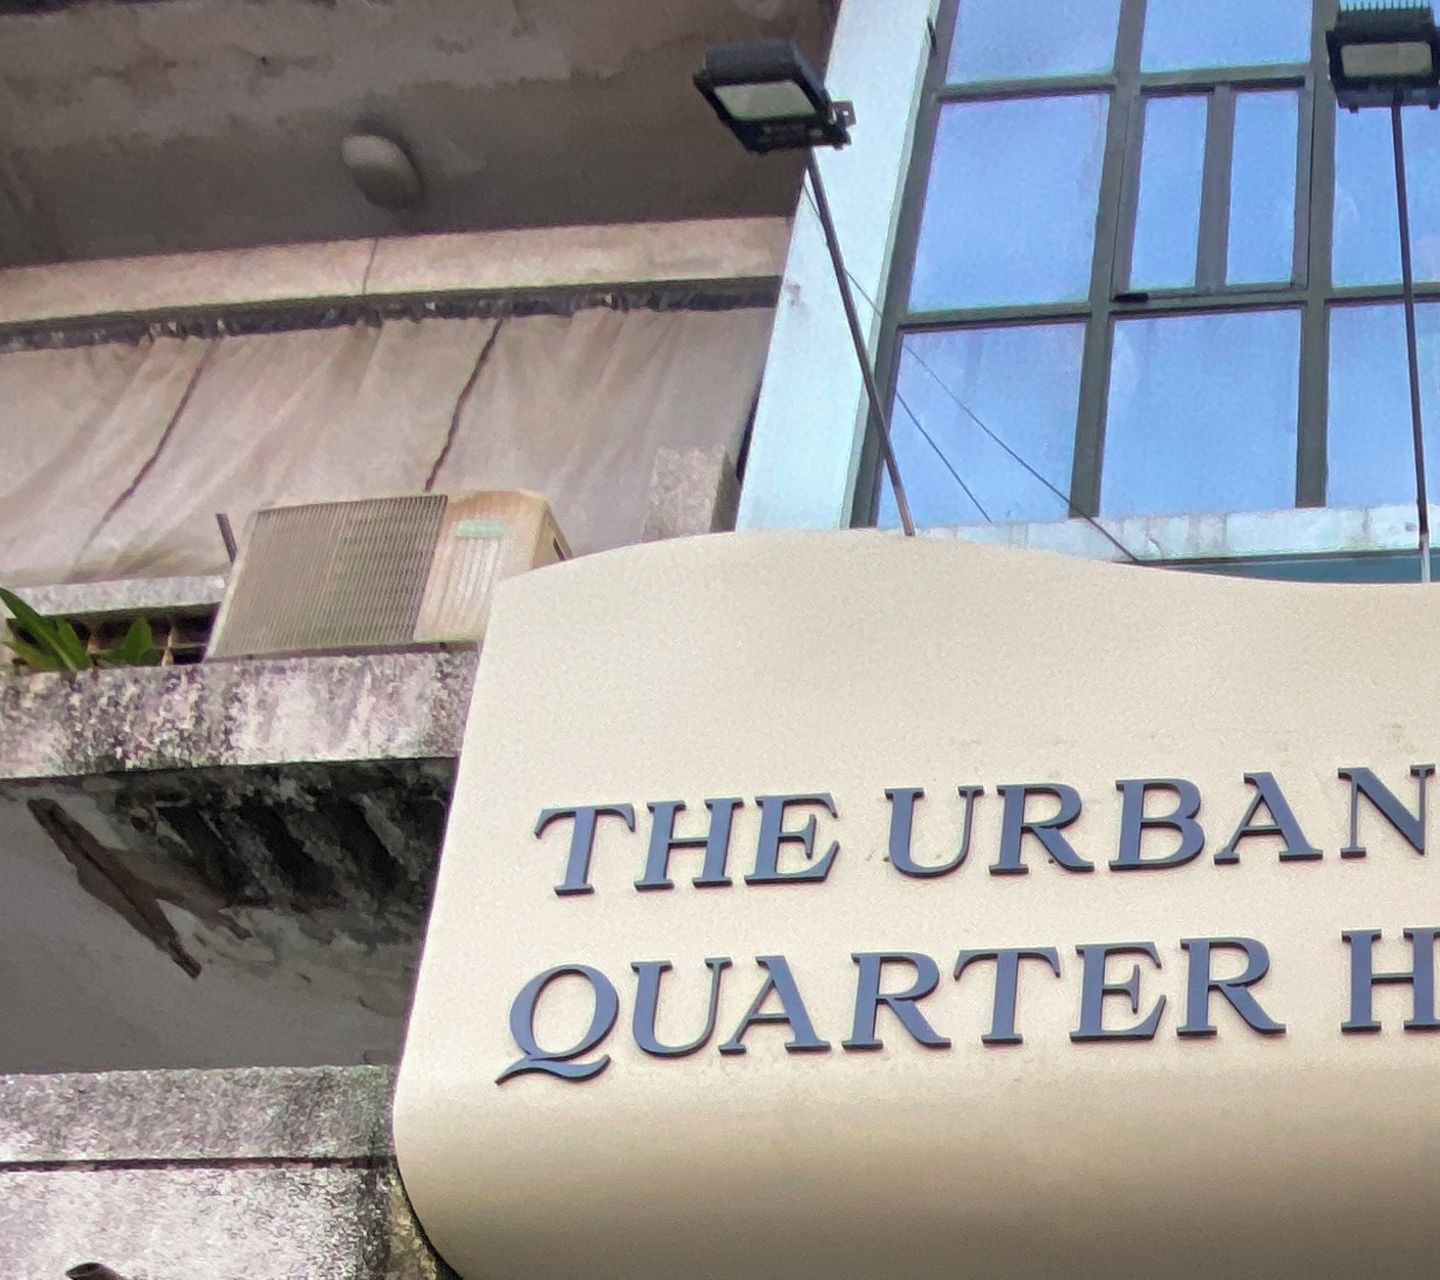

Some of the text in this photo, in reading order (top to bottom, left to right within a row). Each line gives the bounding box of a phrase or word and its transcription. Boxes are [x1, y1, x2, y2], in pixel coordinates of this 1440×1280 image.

[534, 763, 1437, 896] THE URBAN
[493, 935, 1287, 1085] QUARTER
